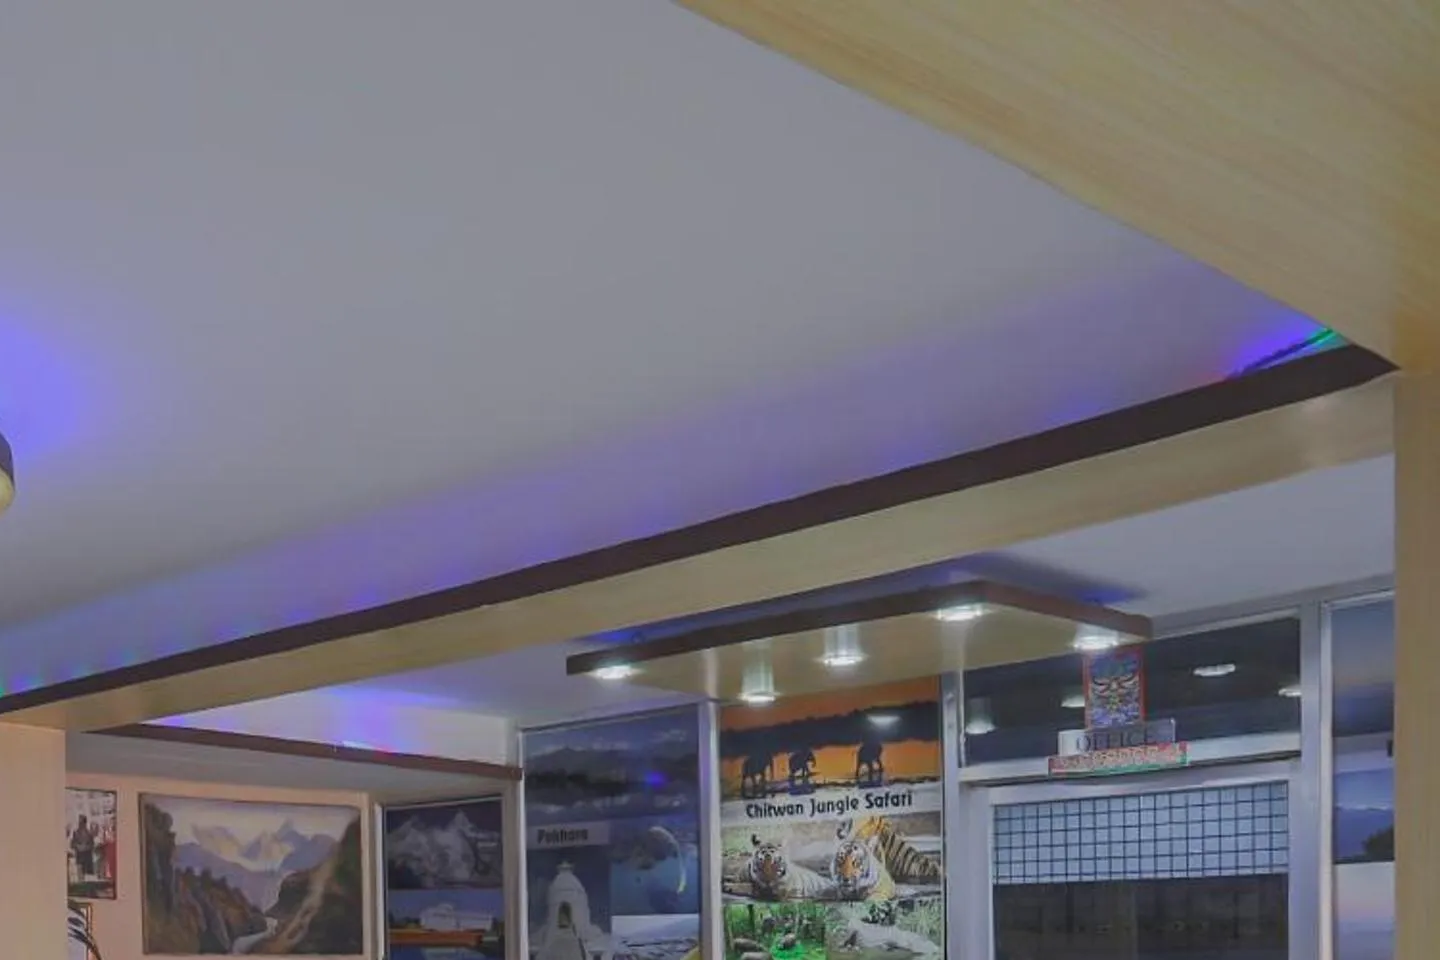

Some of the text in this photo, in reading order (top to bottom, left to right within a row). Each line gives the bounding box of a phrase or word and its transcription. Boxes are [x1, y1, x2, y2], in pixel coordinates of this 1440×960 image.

[745, 790, 913, 819] Chitwan Jungle Safari
